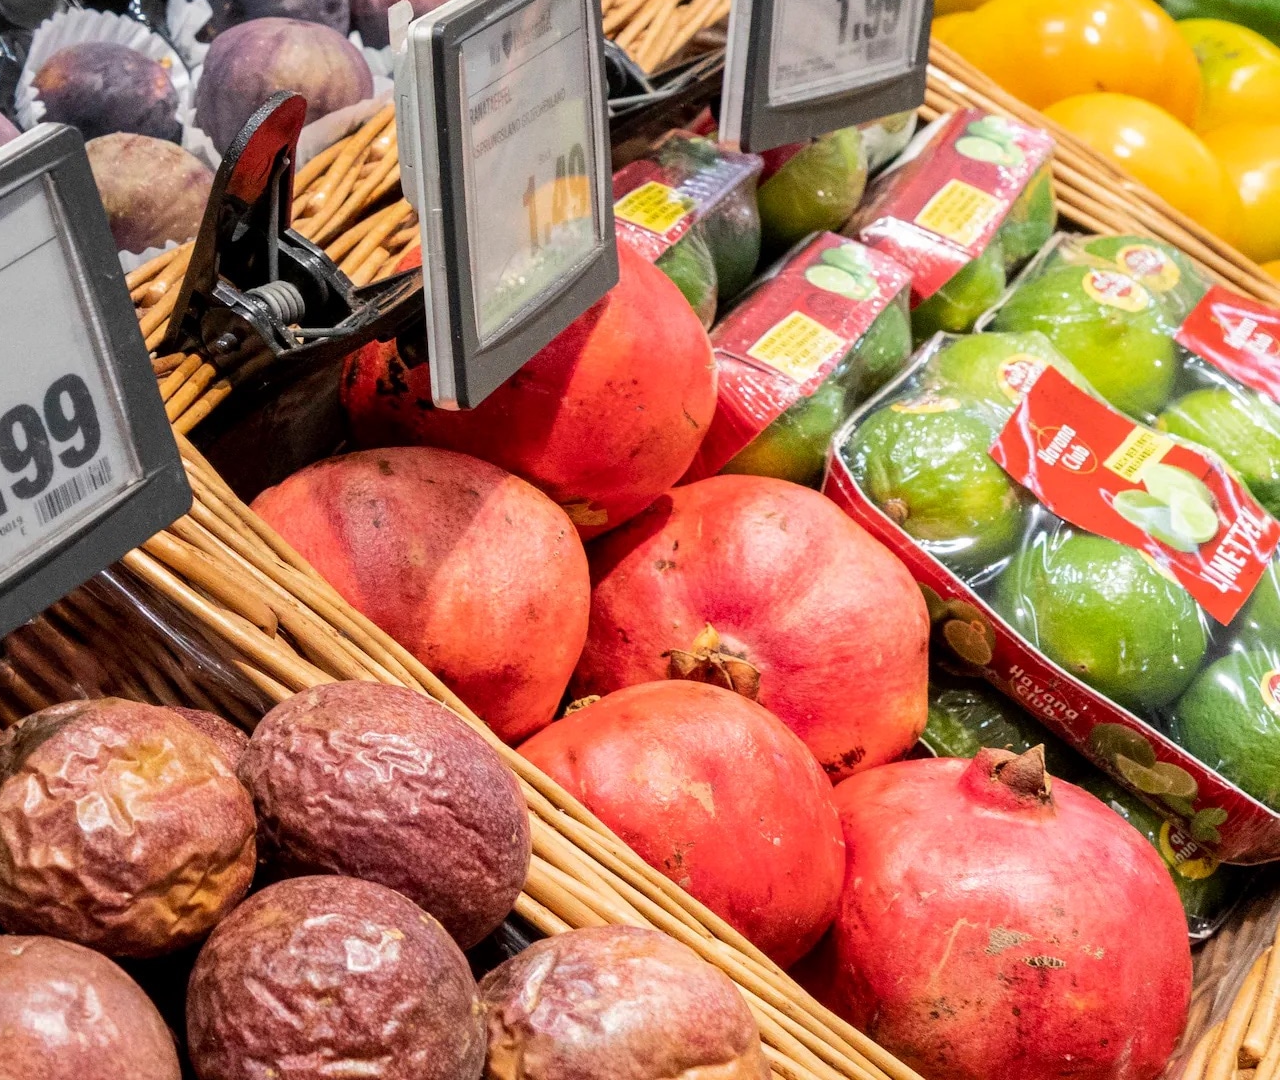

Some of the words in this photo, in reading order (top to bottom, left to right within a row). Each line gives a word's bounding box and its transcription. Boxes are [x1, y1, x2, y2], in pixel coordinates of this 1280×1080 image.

[523, 142, 588, 258] 1.49
[1036, 423, 1077, 467] Havana
[1060, 444, 1091, 471] Club
[1200, 505, 1263, 594] LIMETTEN
[1008, 664, 1080, 721] Havana
[1015, 682, 1057, 718] Club
